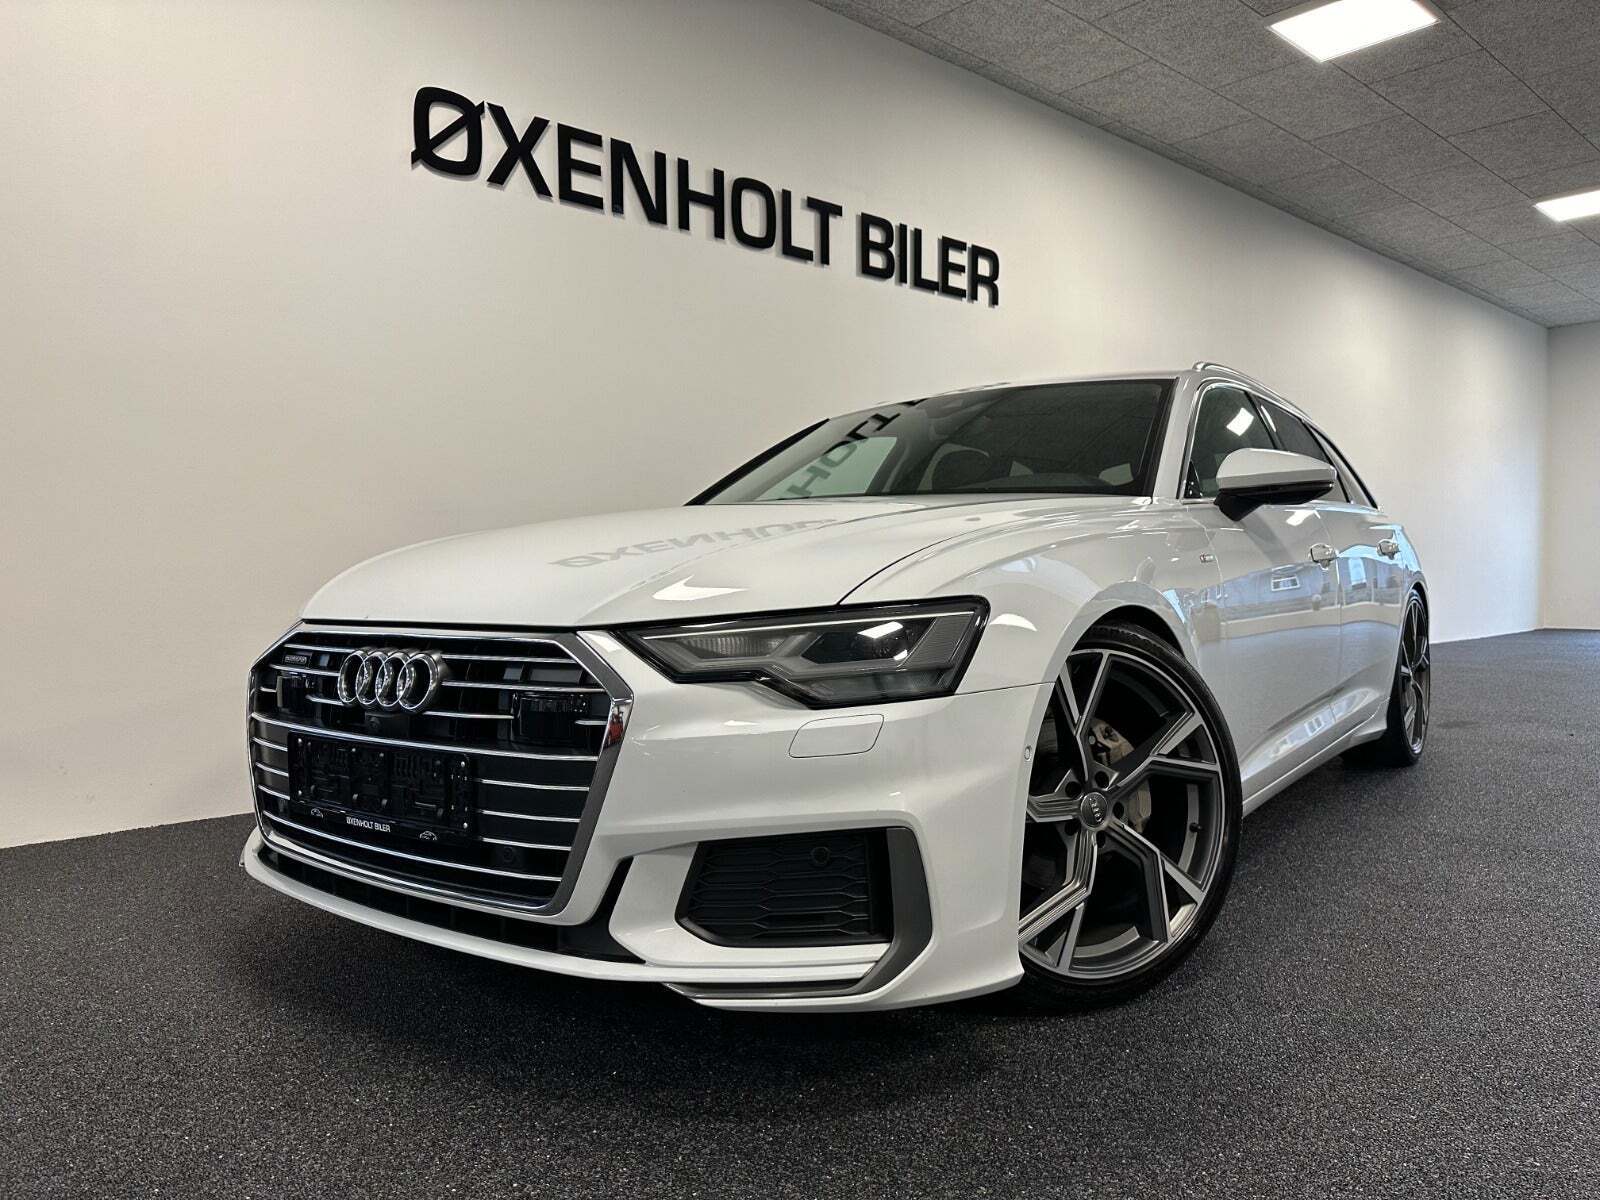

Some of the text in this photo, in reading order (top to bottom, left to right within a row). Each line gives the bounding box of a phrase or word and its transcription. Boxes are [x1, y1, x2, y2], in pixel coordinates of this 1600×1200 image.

[411, 86, 1000, 307] ØXENHOLT BILER
[345, 816, 391, 832] ØXENHOLT BILER
